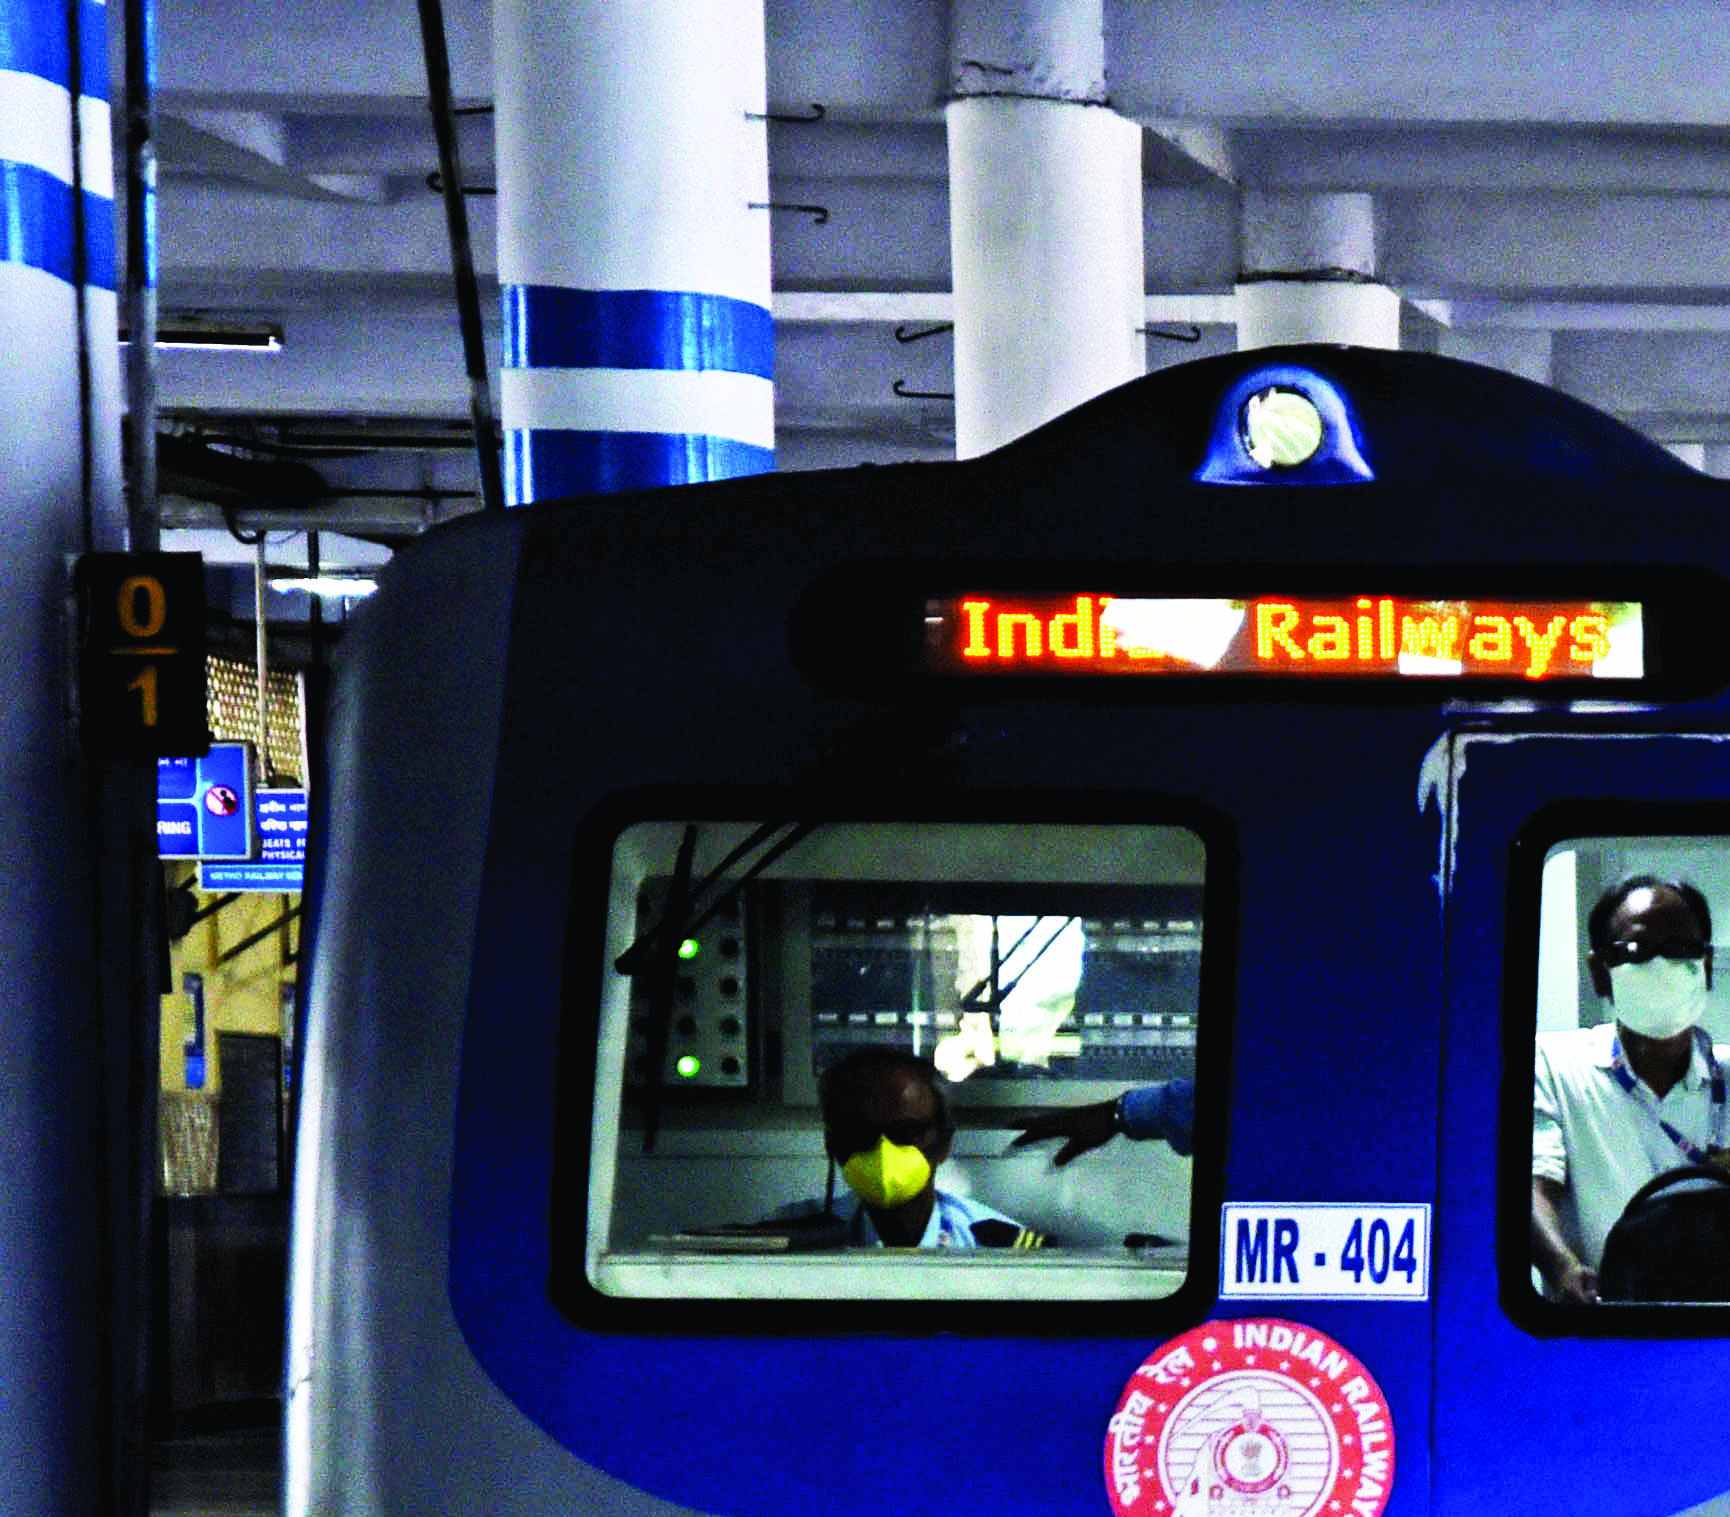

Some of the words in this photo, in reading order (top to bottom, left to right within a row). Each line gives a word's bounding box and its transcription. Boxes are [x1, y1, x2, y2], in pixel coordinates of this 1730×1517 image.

[963, 597, 1165, 658] Indi
[1256, 599, 1610, 678] Railways
[127, 665, 158, 727] 1
[1235, 1218, 1299, 1284] MR
[1340, 1218, 1417, 1284] 404
[1234, 1324, 1348, 1380] INDIAN
[1108, 1390, 1154, 1507] भारतीय
[1135, 1346, 1195, 1383] रेल
